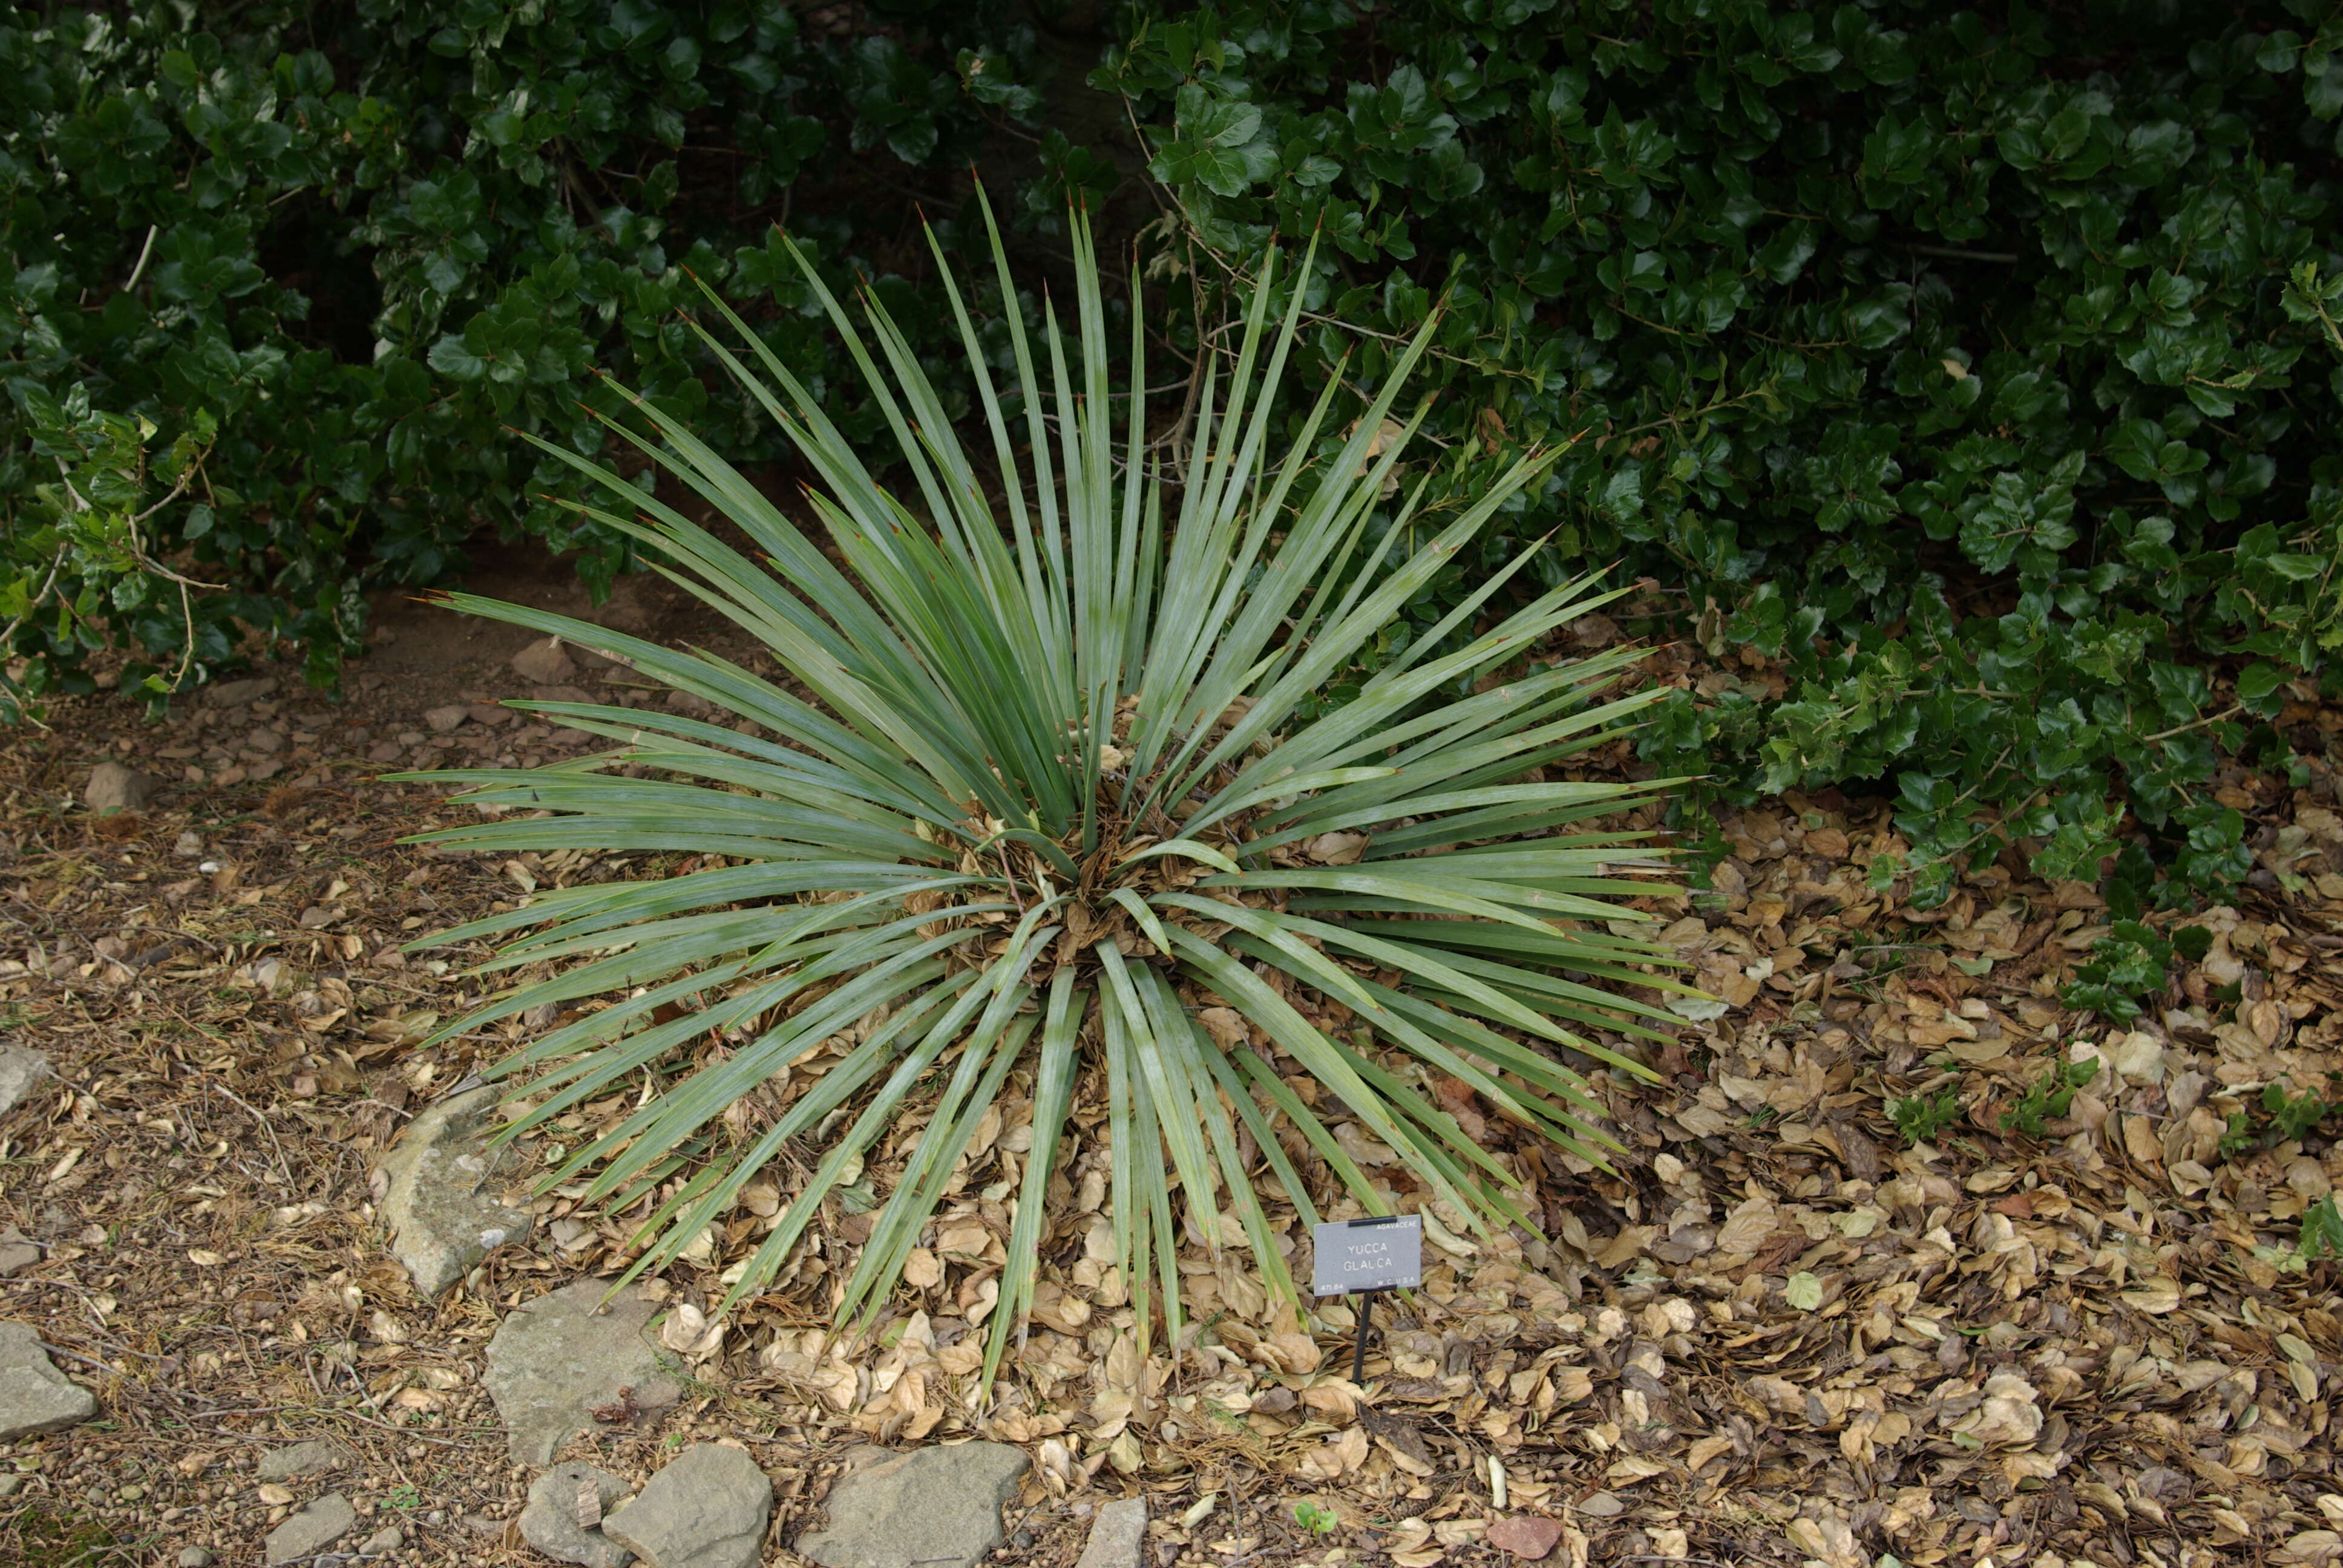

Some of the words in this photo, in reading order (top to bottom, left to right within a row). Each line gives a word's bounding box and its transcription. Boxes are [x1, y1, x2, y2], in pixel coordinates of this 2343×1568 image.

[1376, 1220, 1417, 1230] AGAVACEAE
[1348, 1243, 1388, 1255] YUCCA
[1343, 1258, 1392, 1271] GLAUCA
